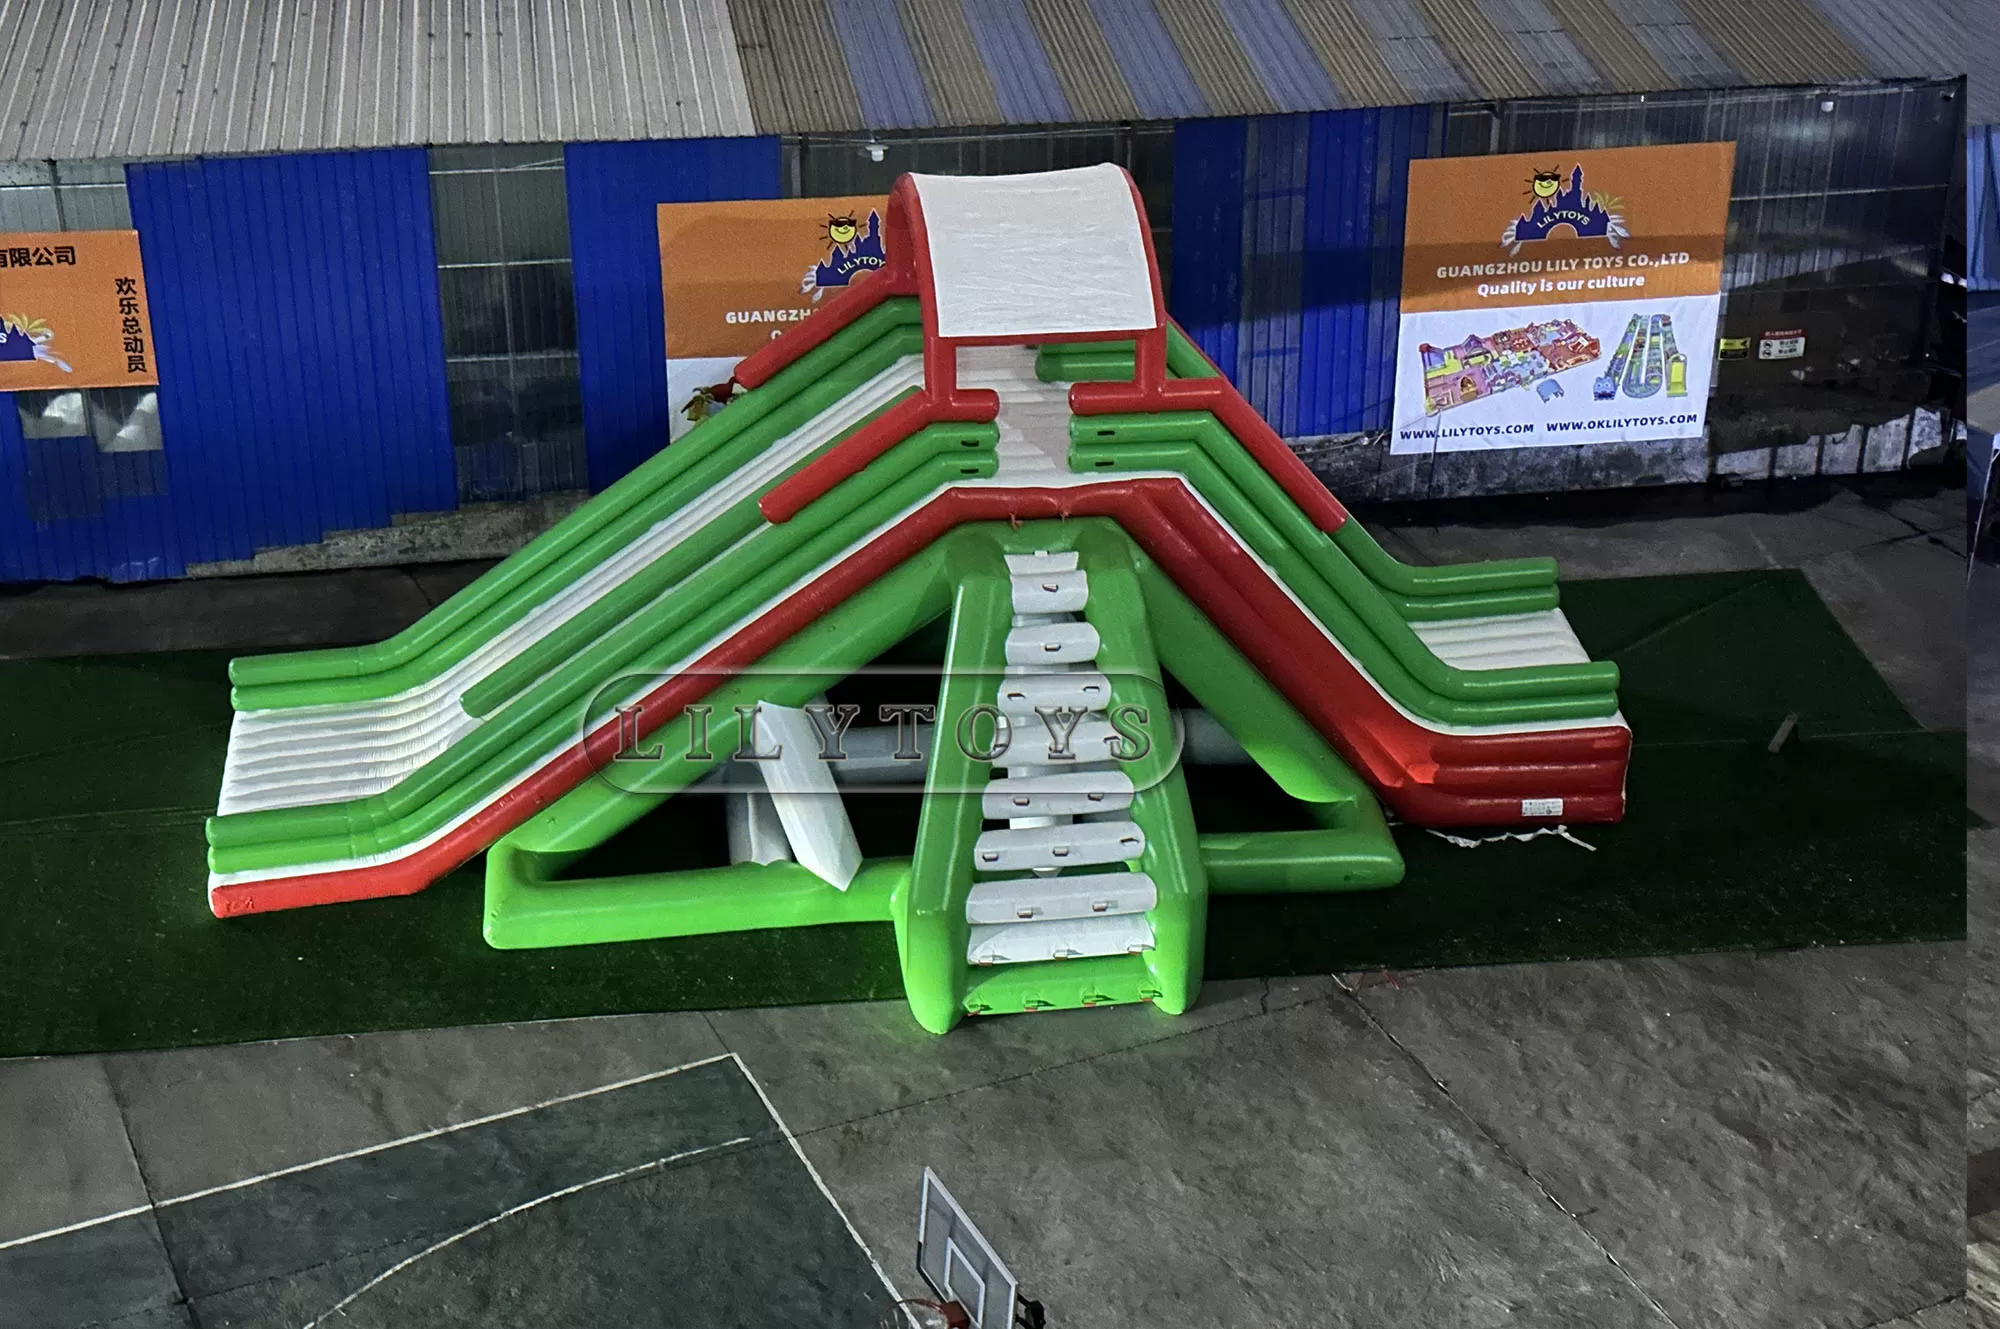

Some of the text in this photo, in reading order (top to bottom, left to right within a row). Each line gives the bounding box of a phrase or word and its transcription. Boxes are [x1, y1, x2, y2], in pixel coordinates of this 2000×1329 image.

[1536, 211, 1590, 229] LILYTOYS
[837, 256, 885, 275] LILYTOY
[1436, 251, 1690, 279] GUANGZHOU LILY TOYS CO.,LTD
[1477, 275, 1645, 298] Quality is our culture
[115, 277, 147, 373] 欢乐总动员
[725, 308, 820, 324] GUANGZH
[1399, 413, 1698, 440] WWW.LILYTOYS.COM WWW.OKLILYTOYS.COM
